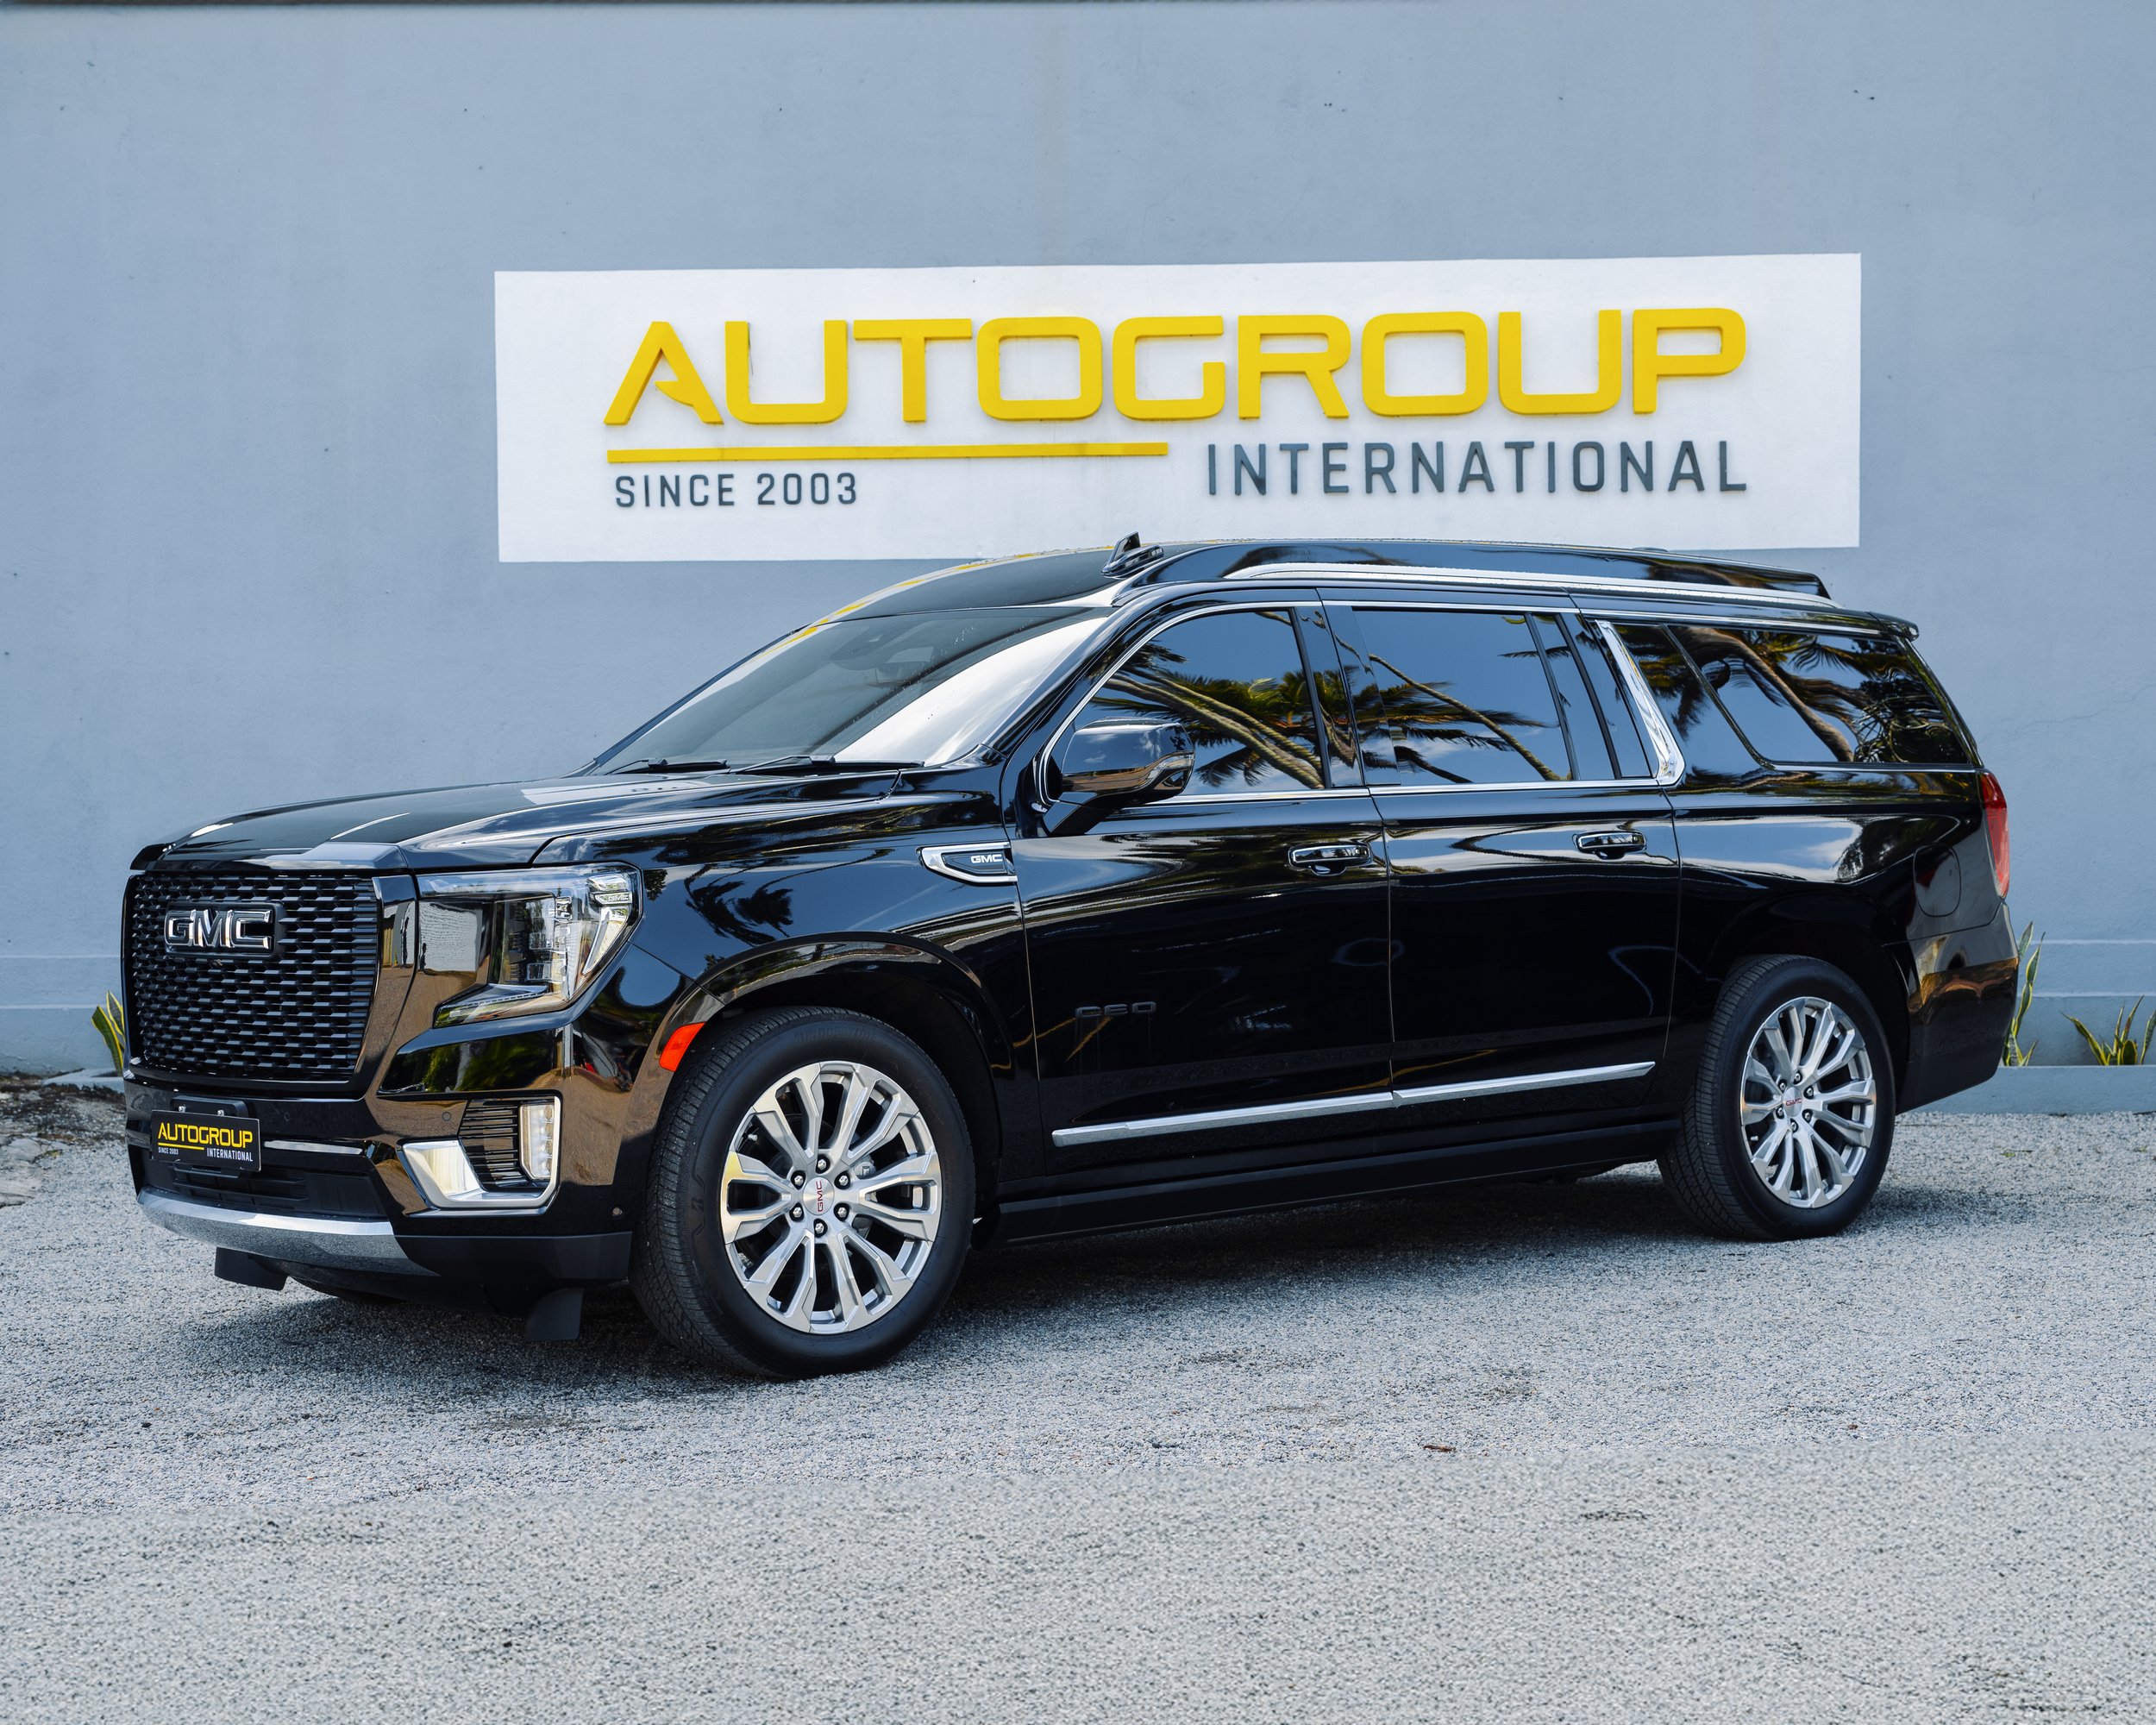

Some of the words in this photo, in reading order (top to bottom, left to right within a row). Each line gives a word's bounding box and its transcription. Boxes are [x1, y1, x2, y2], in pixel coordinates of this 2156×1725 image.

[604, 307, 1746, 427] AUTOGROUP
[1207, 440, 1747, 496] INTERNATIONAL
[615, 474, 736, 507] SINCE
[756, 472, 857, 505] 2003
[970, 854, 1003, 863] GMC
[164, 908, 273, 950] GMC
[1785, 1098, 1802, 1107] GMC
[157, 1122, 254, 1148] AUTOGROUP
[158, 1146, 169, 1155] SINCE
[206, 1147, 254, 1162] INTERNATIONAL
[815, 1180, 824, 1213] GMC
